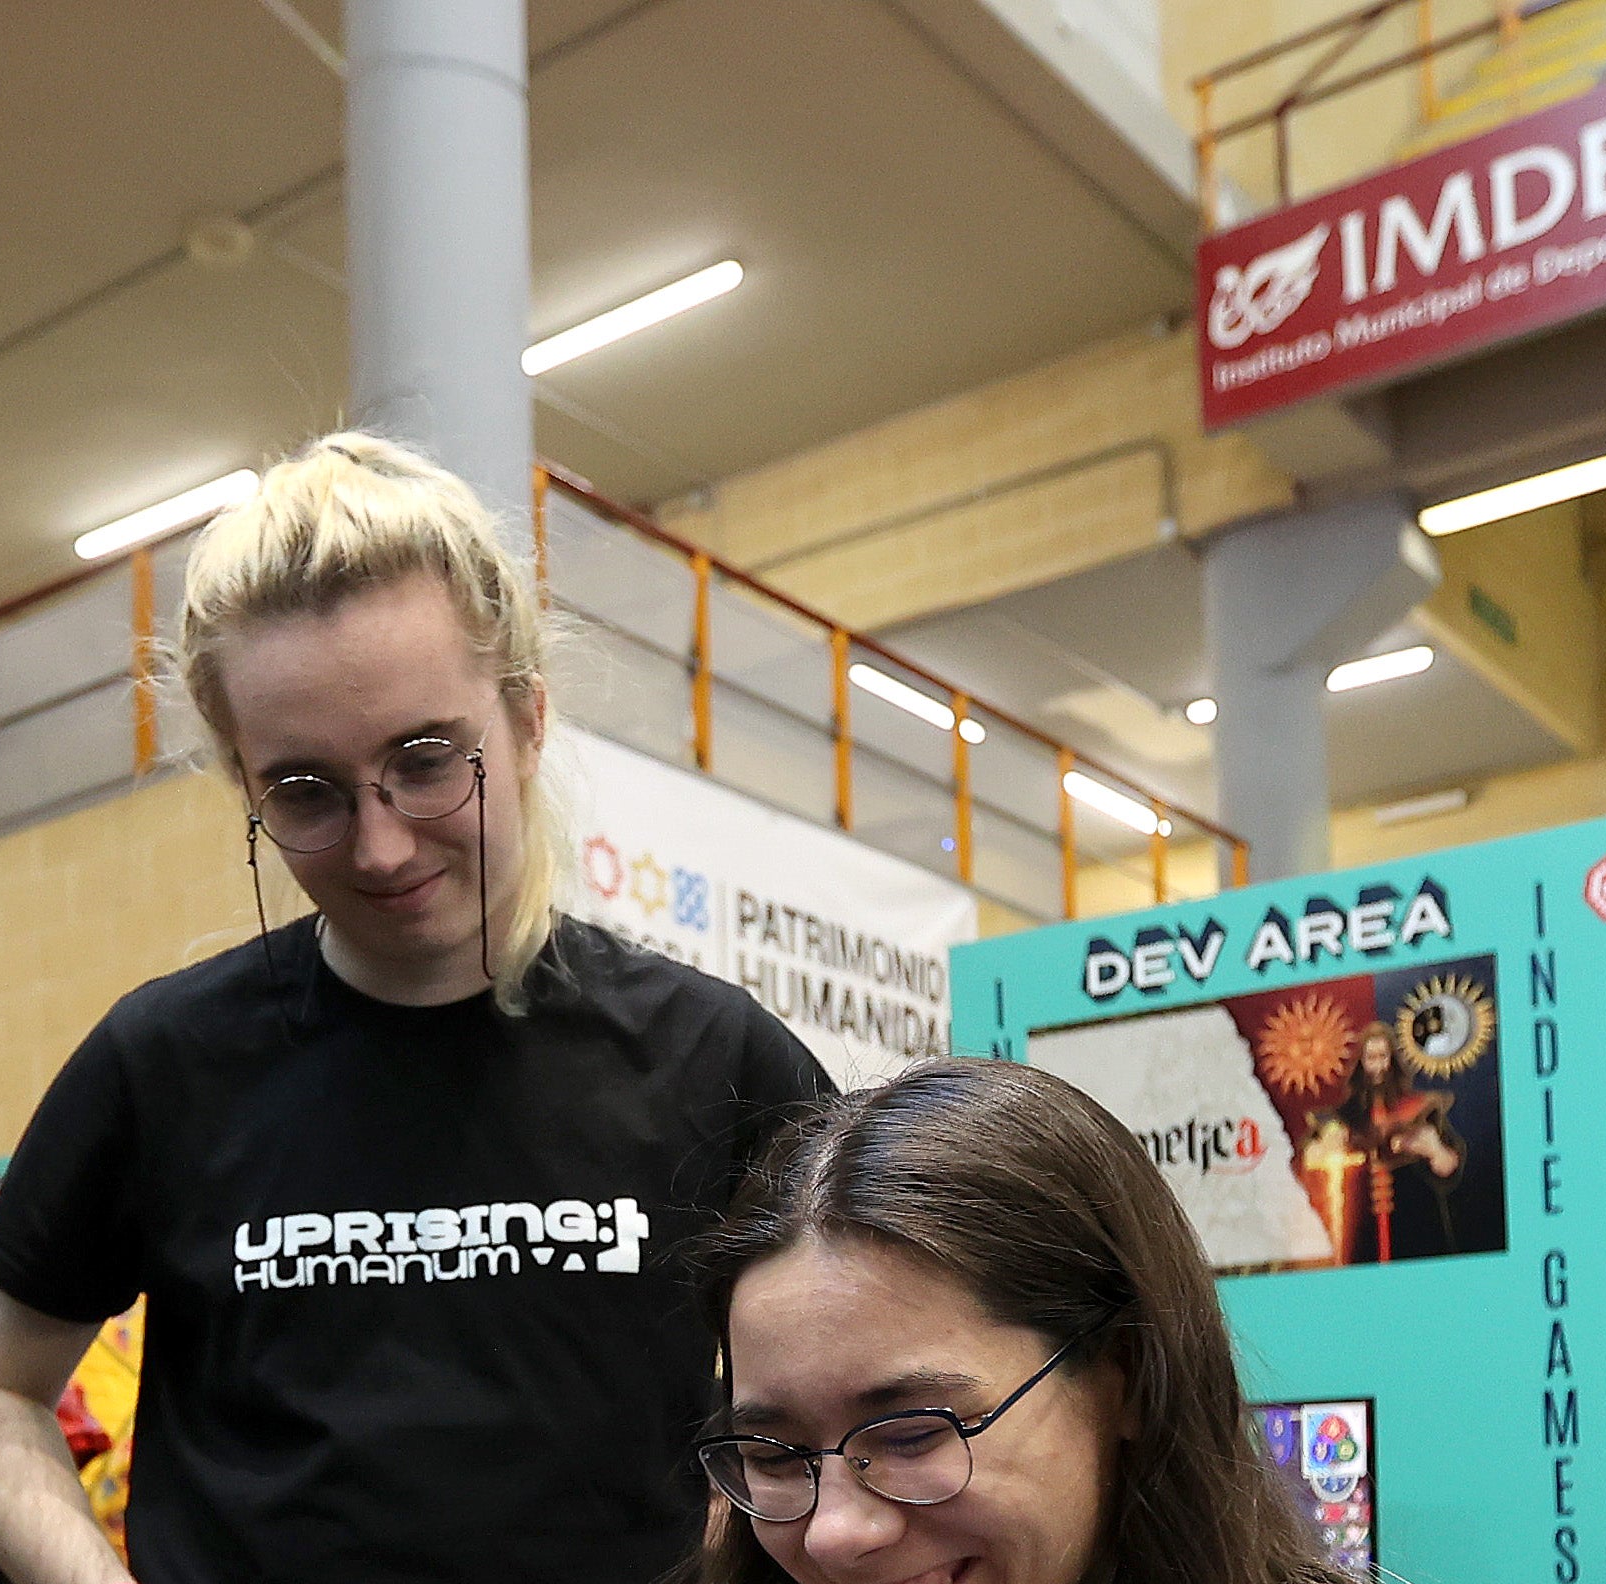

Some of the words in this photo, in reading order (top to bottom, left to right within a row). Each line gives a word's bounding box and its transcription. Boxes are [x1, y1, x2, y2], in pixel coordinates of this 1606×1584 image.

[1213, 330, 1331, 392] Instituto
[1332, 273, 1484, 353] Municipal
[1484, 263, 1531, 302] de
[736, 889, 946, 1003] PATRIMONIO
[1084, 918, 1226, 1000] DEV
[1246, 875, 1453, 973] AREA
[738, 954, 943, 1058] HUMANIDA
[1532, 884, 1564, 1216] INDIE
